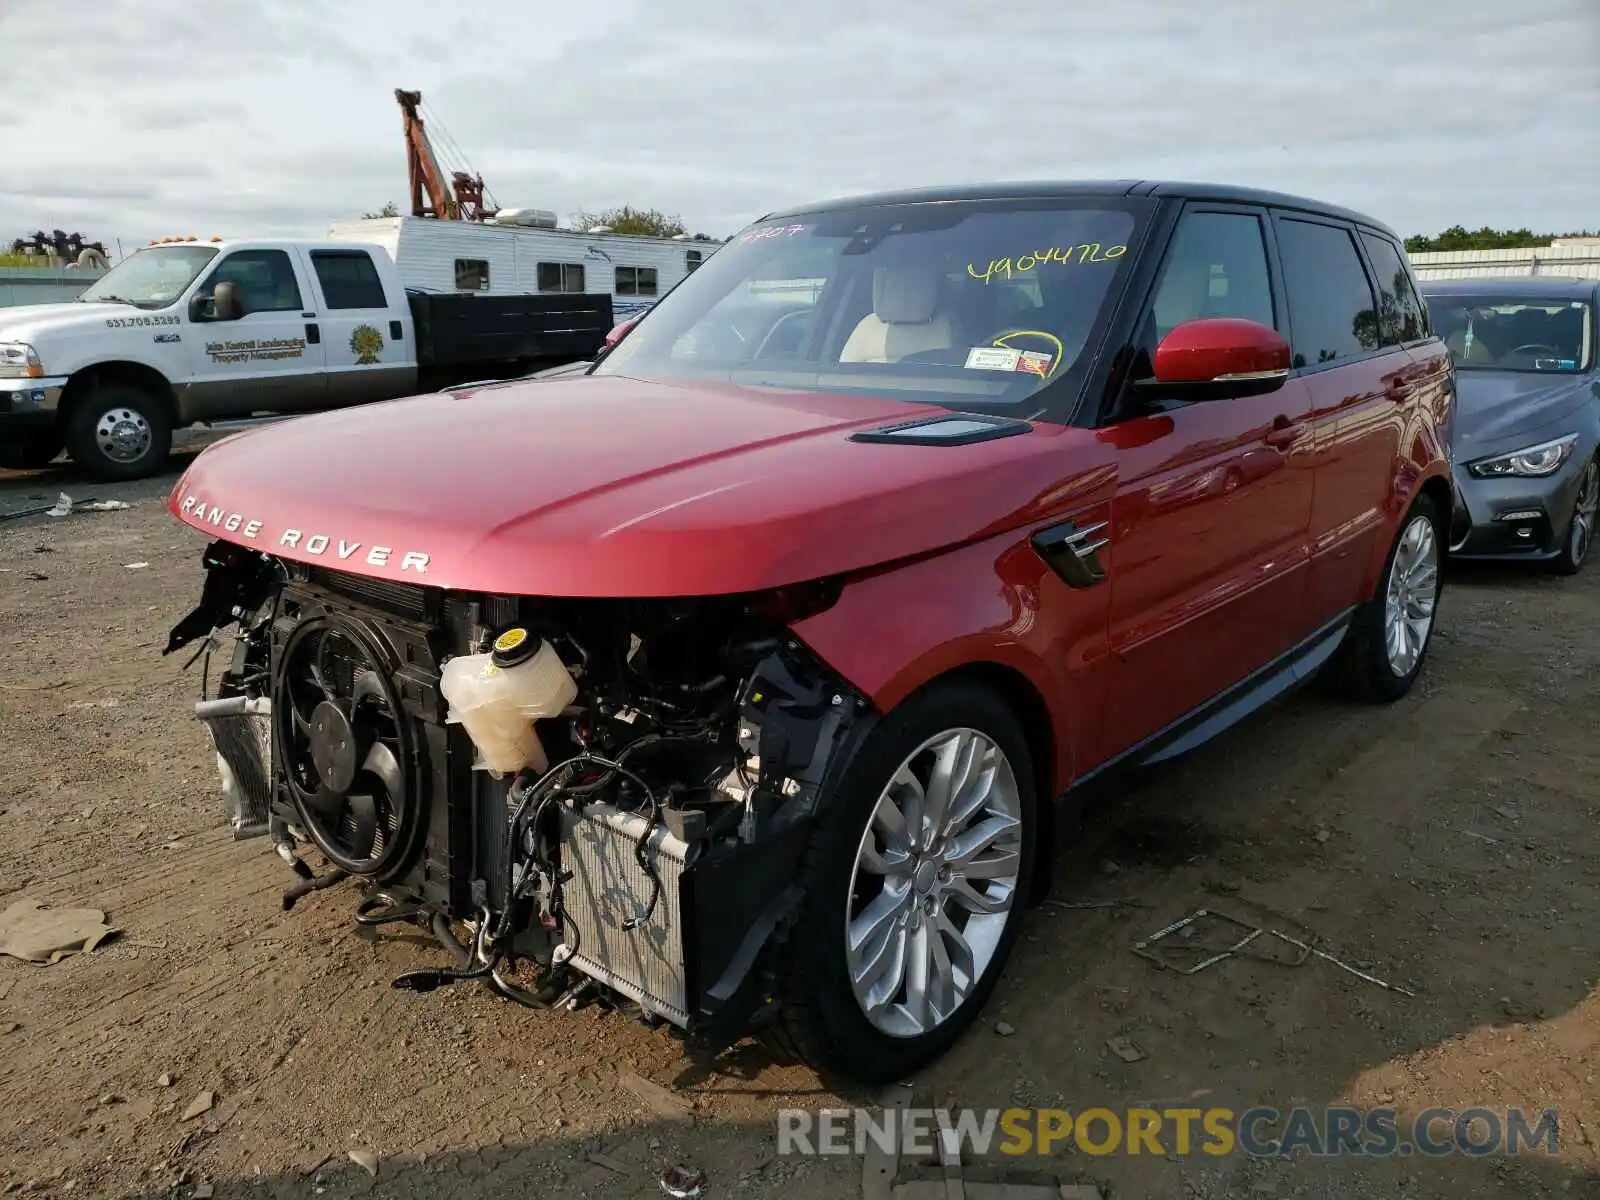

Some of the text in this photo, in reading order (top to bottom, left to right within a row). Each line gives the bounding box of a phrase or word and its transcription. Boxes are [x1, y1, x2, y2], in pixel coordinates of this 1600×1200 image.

[212, 347, 303, 364] Property Management
[181, 496, 430, 573] RANGE ROVER
